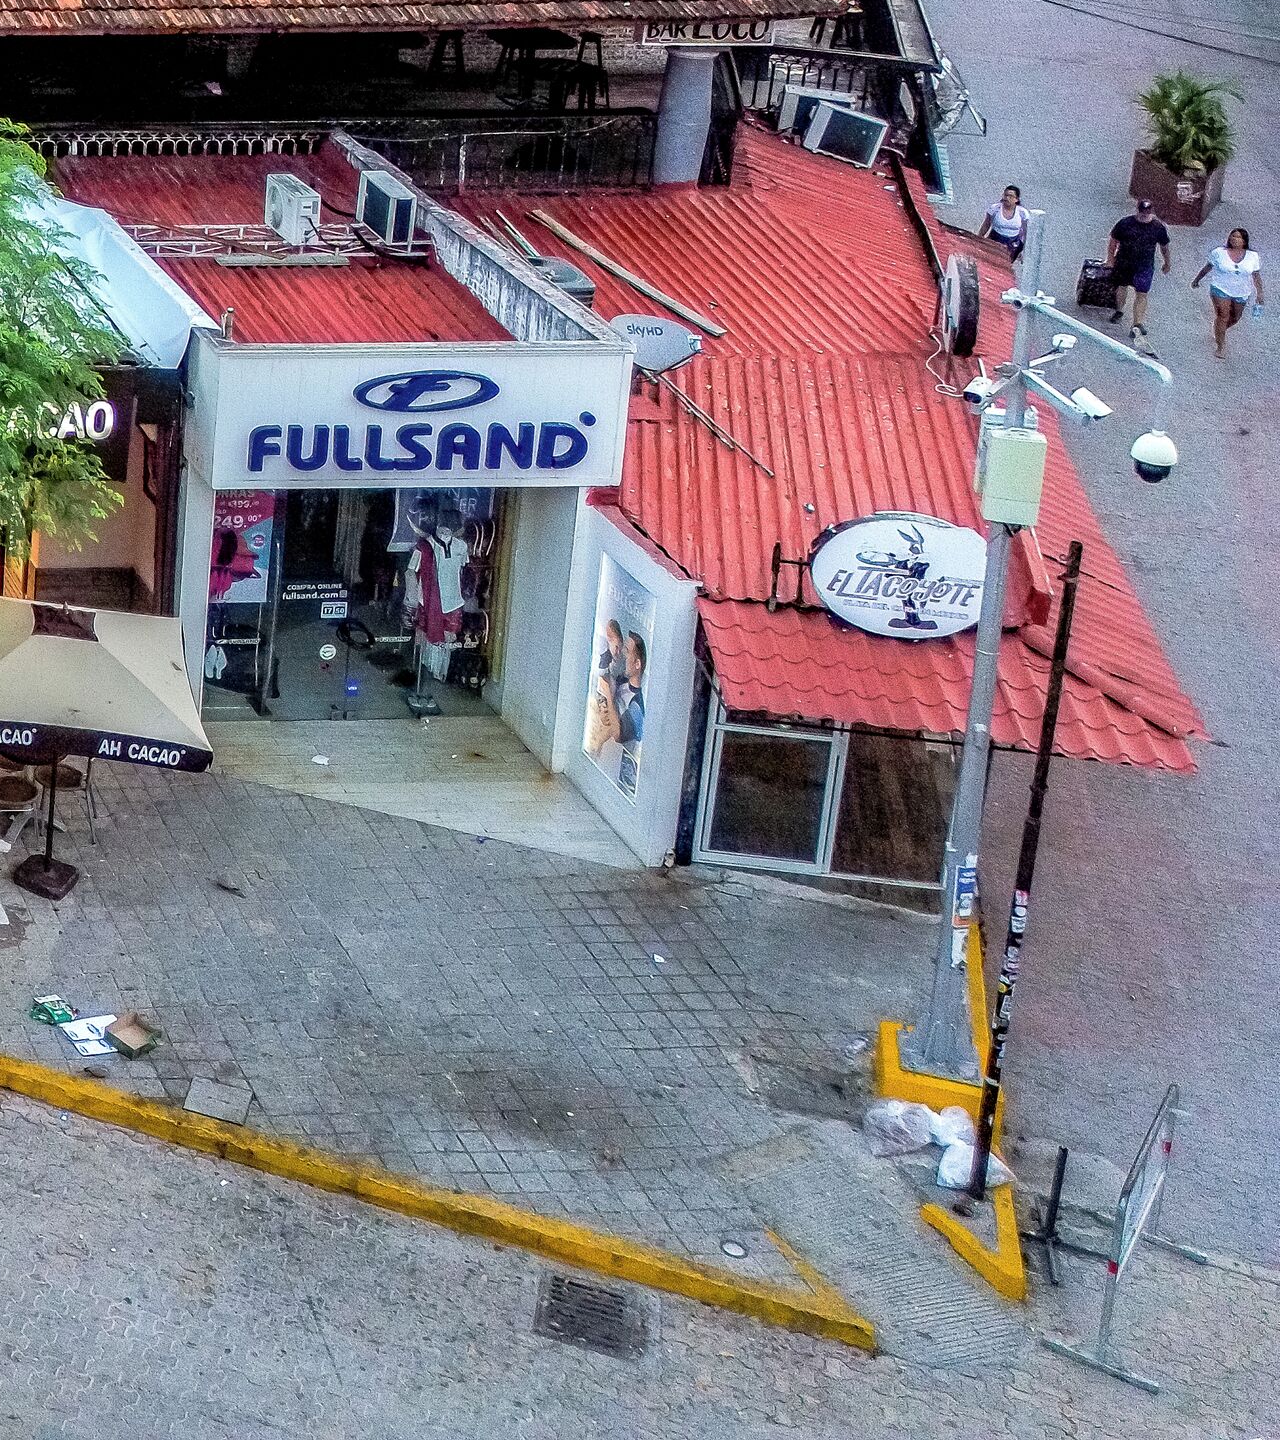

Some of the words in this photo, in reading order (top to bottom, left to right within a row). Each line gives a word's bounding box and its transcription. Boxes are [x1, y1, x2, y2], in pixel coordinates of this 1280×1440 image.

[646, 21, 687, 41] BAR
[692, 20, 770, 41] LOCO
[246, 421, 589, 473] FULLSAND
[282, 590, 339, 601] fullsand.com
[286, 583, 317, 591] COMPRA
[317, 582, 343, 590] ONLINE
[827, 569, 870, 600] EL
[97, 738, 122, 757] AH
[127, 743, 181, 767] CACAO
